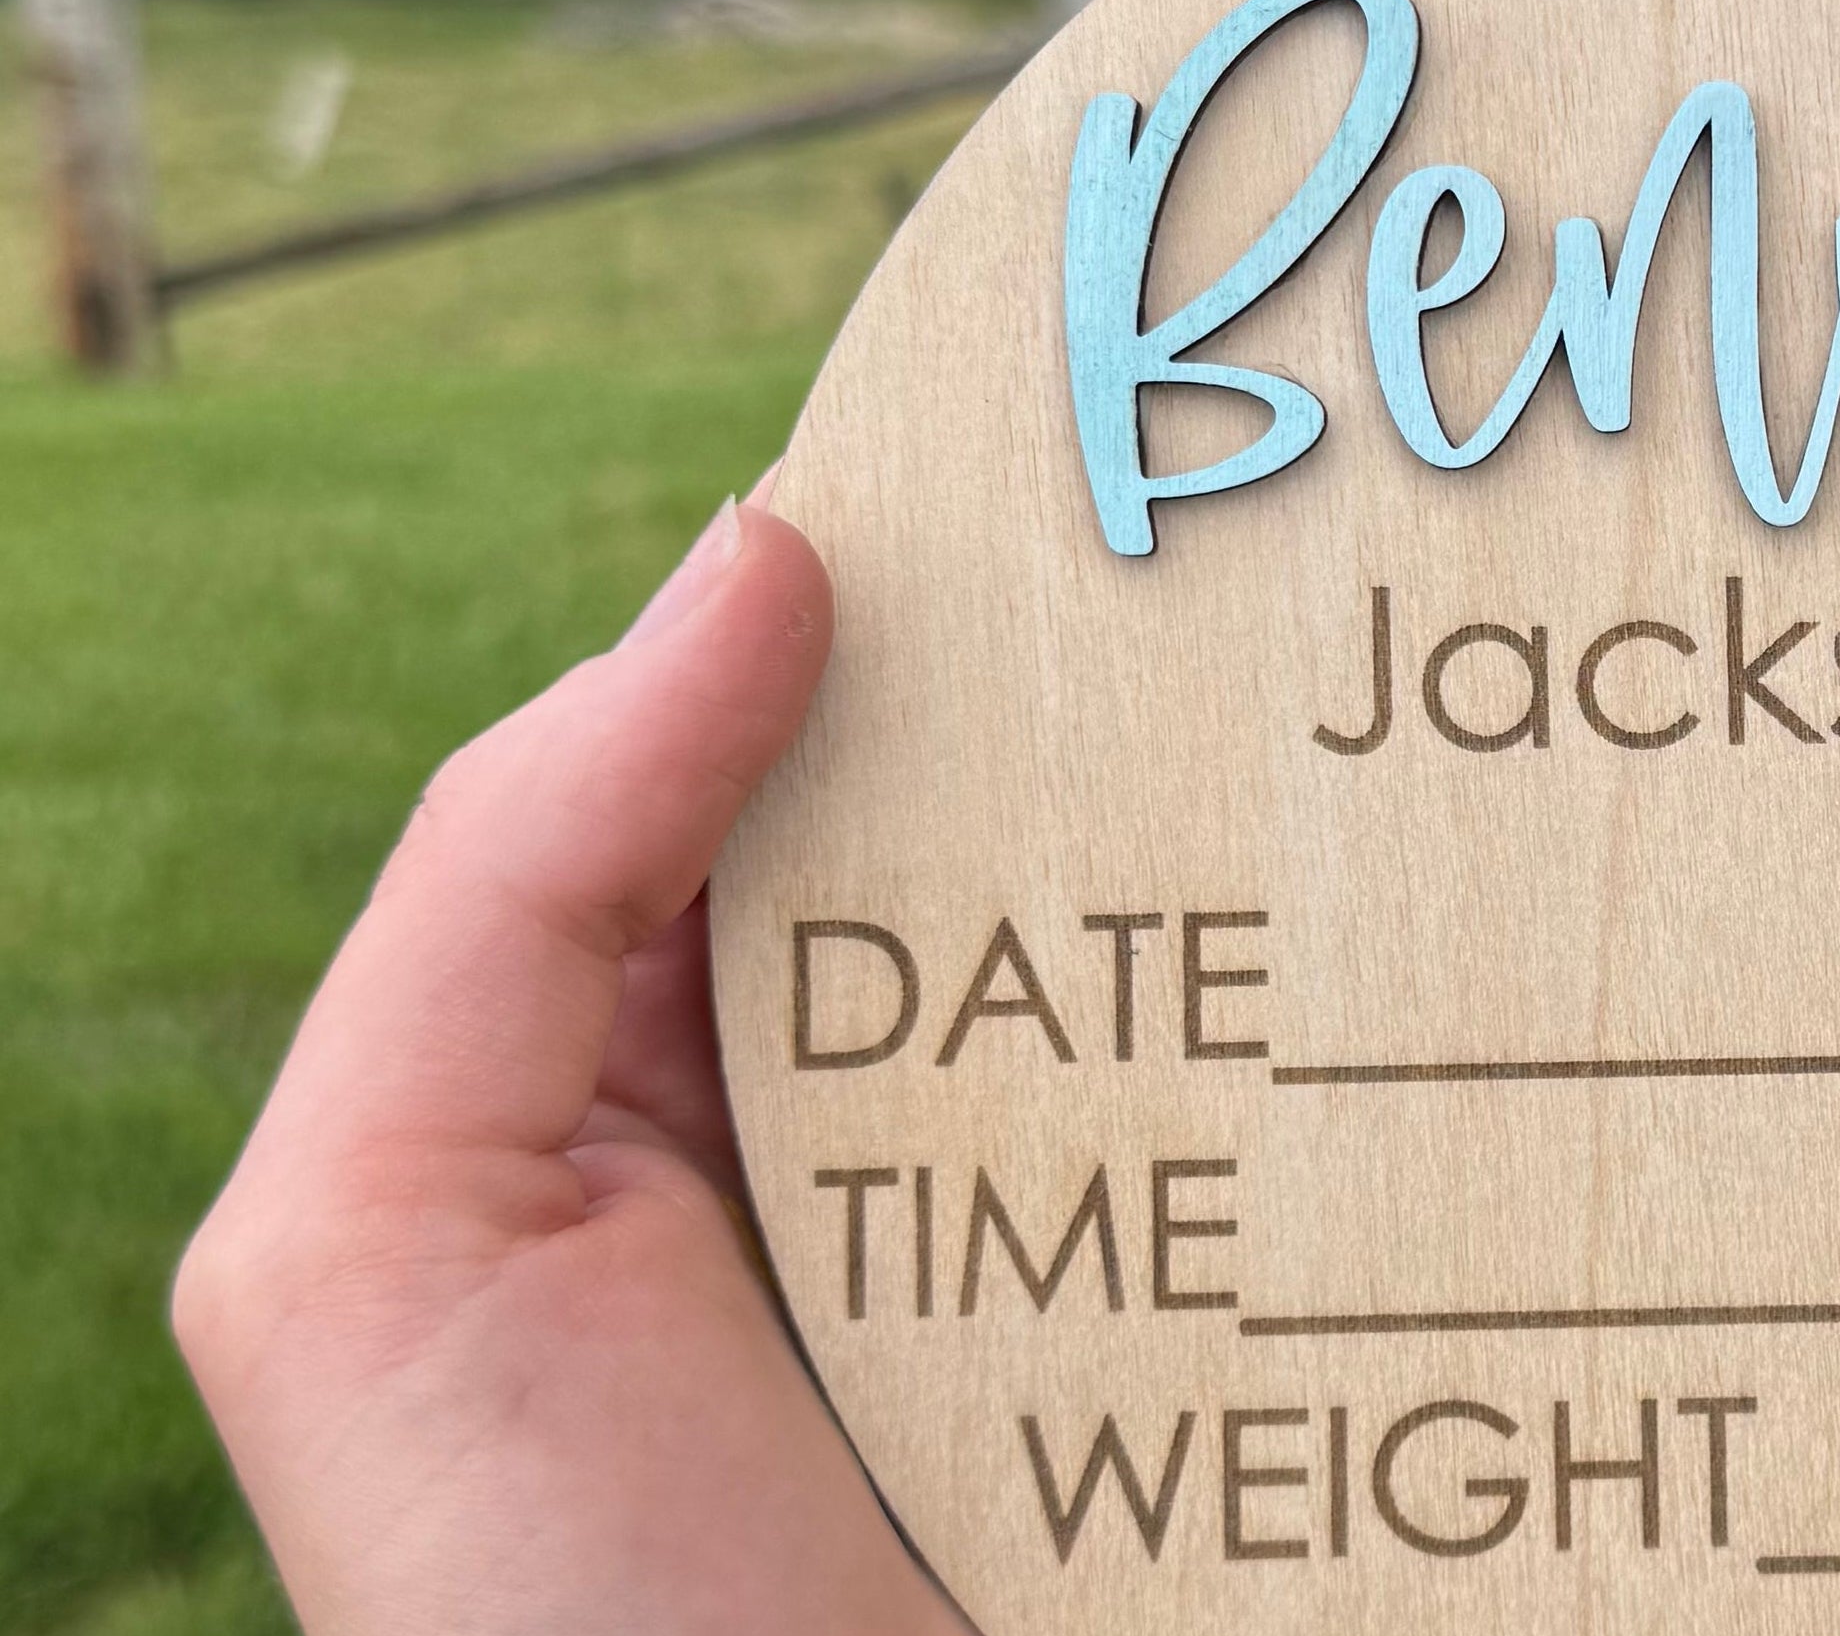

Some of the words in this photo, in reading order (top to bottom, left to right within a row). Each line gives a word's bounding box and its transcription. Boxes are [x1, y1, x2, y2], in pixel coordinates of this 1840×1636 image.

[791, 910, 1270, 1071] DATE
[814, 1158, 1239, 1320] TIME
[1019, 1393, 1757, 1565] WEIGHT
